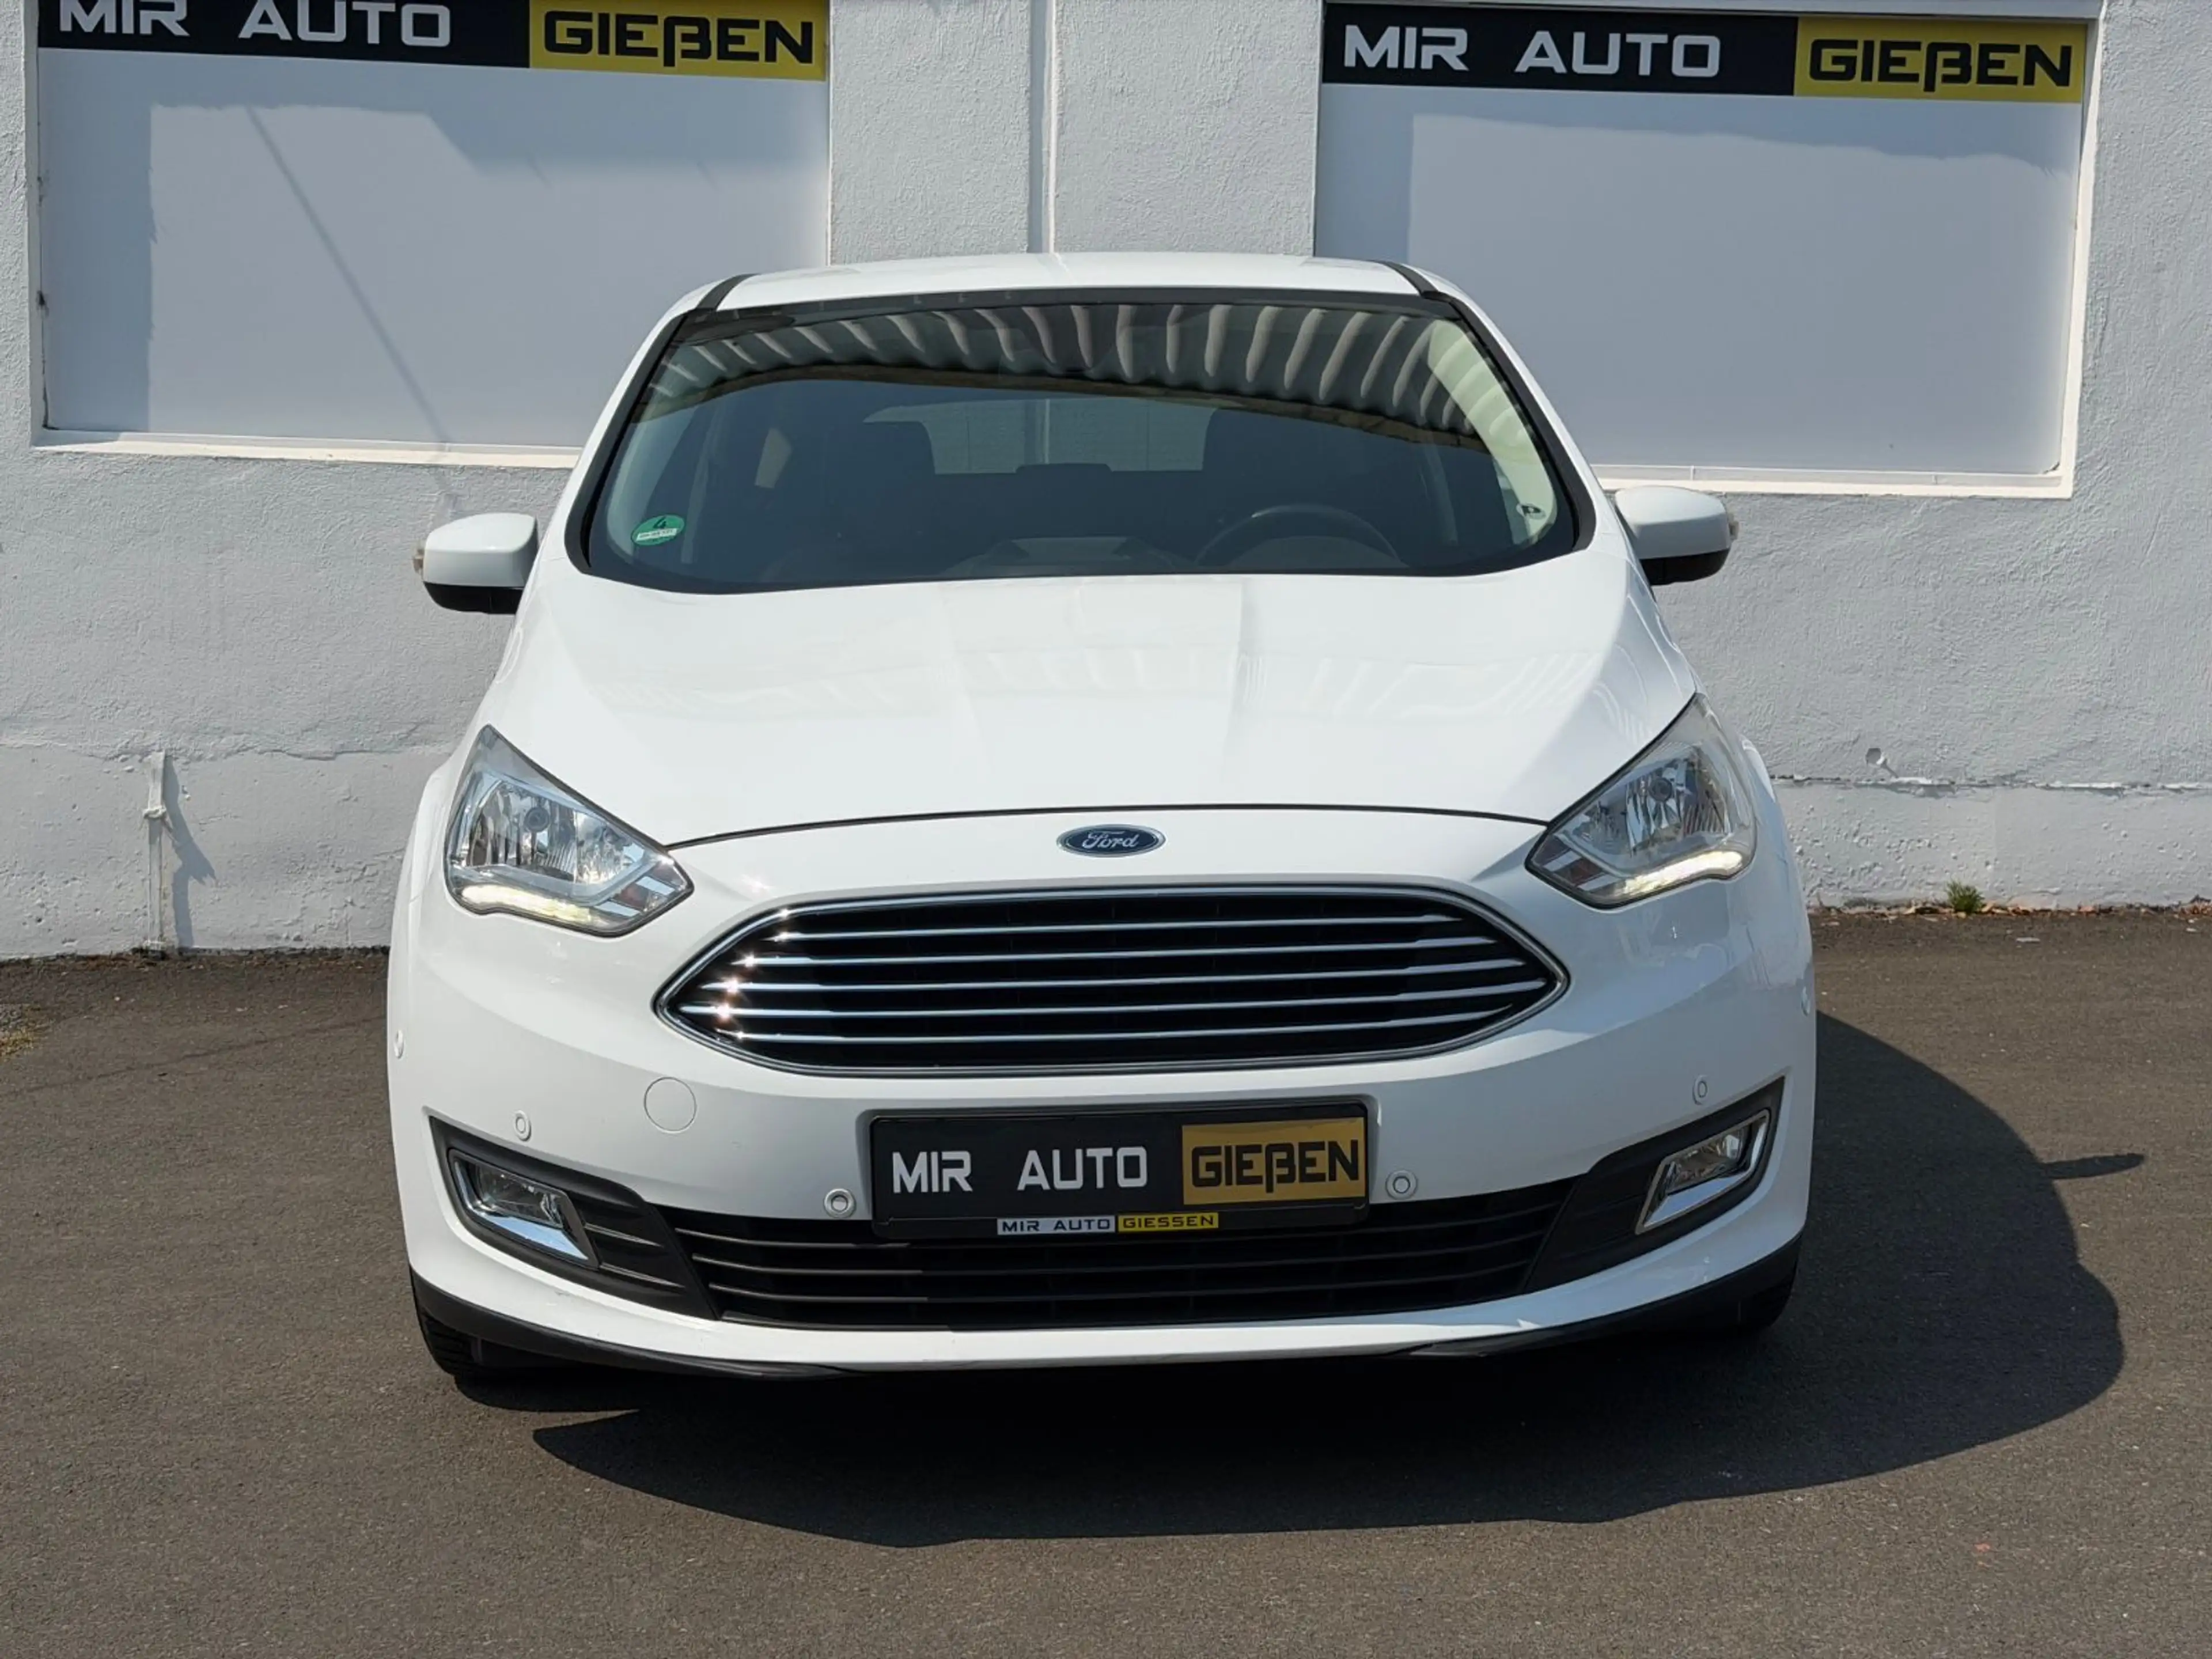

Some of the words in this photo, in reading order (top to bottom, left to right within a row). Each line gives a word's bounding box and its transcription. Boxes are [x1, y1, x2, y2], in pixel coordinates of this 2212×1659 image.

[59, 0, 190, 36] MIR
[238, 0, 451, 47] AUTO
[1344, 25, 1469, 71] MIR
[1514, 31, 1721, 77] AUTO
[1082, 831, 1139, 849] Ford
[892, 1150, 974, 1194] MIR
[1017, 1146, 1148, 1191] AUTO
[1054, 1218, 1111, 1231] AUTO
[1123, 1215, 1214, 1229] GIESSEN
